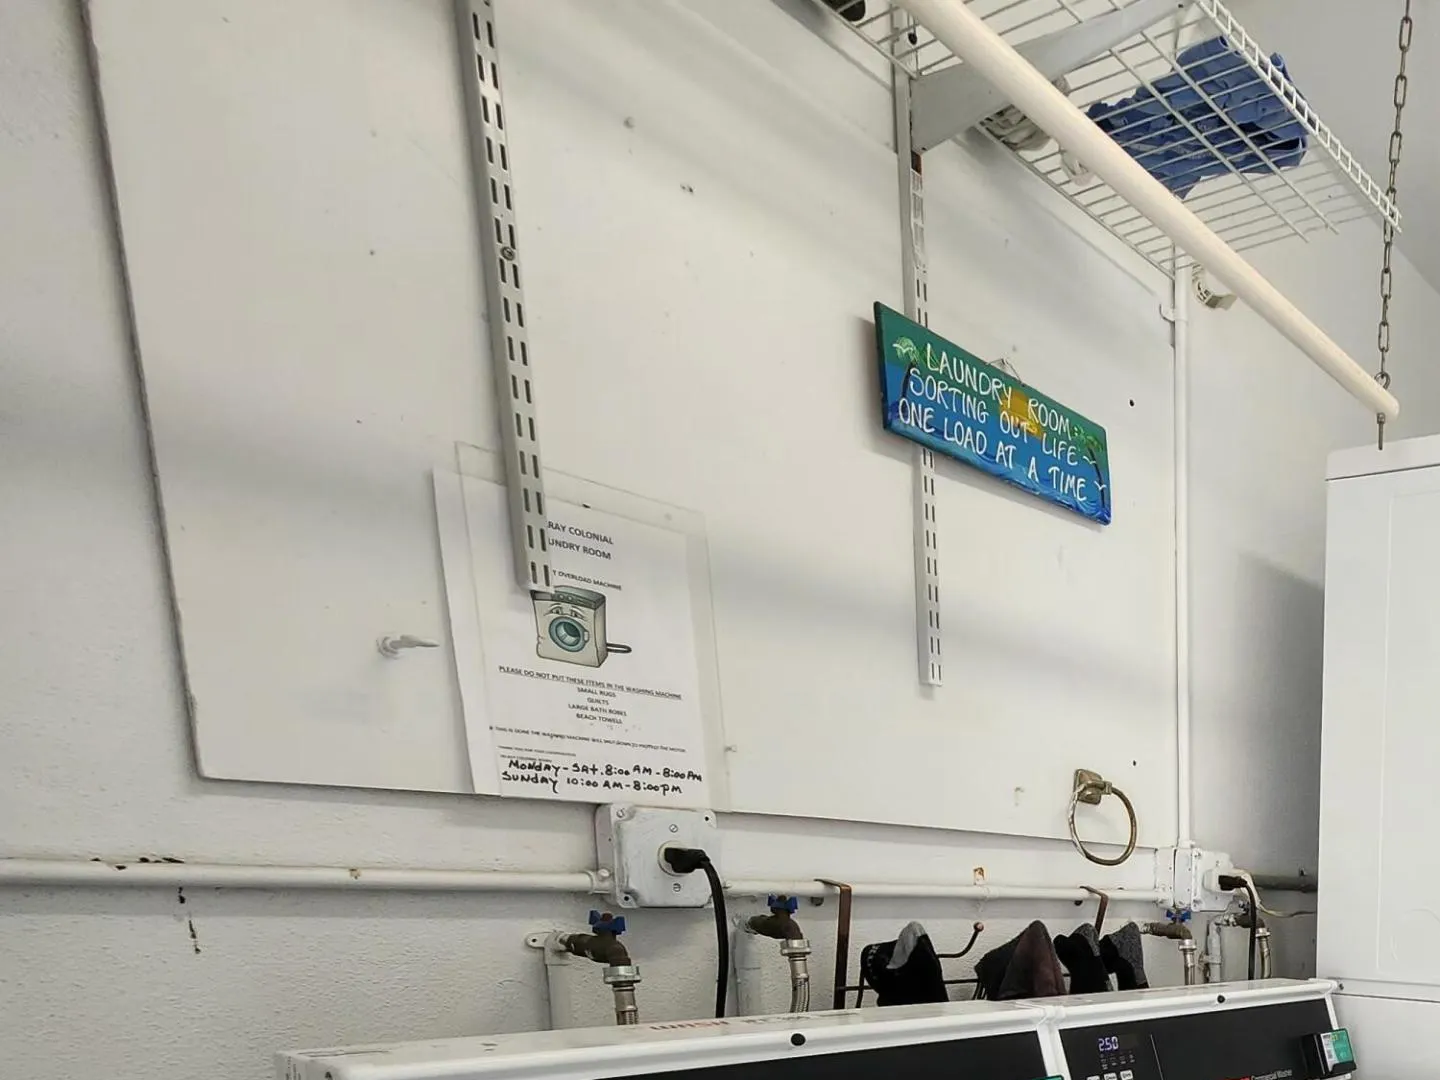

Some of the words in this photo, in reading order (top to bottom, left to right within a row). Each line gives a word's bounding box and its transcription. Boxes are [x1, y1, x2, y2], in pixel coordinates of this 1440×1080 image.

[926, 342, 1012, 408] LAUNDRY
[1027, 398, 1072, 440] ROOM
[909, 367, 989, 424] SORTING
[999, 410, 1029, 444] OUT
[1042, 433, 1078, 466] LIFE
[898, 397, 936, 433] ONE
[944, 417, 987, 455] LOAD
[995, 441, 1017, 469] AT
[1028, 456, 1040, 482] A
[1048, 466, 1087, 501] TIME
[568, 526, 614, 545] COLONIAL
[548, 538, 580, 552] UNDRY
[582, 545, 611, 560] ROOM
[632, 765, 652, 775] AM
[602, 780, 623, 790] AM
